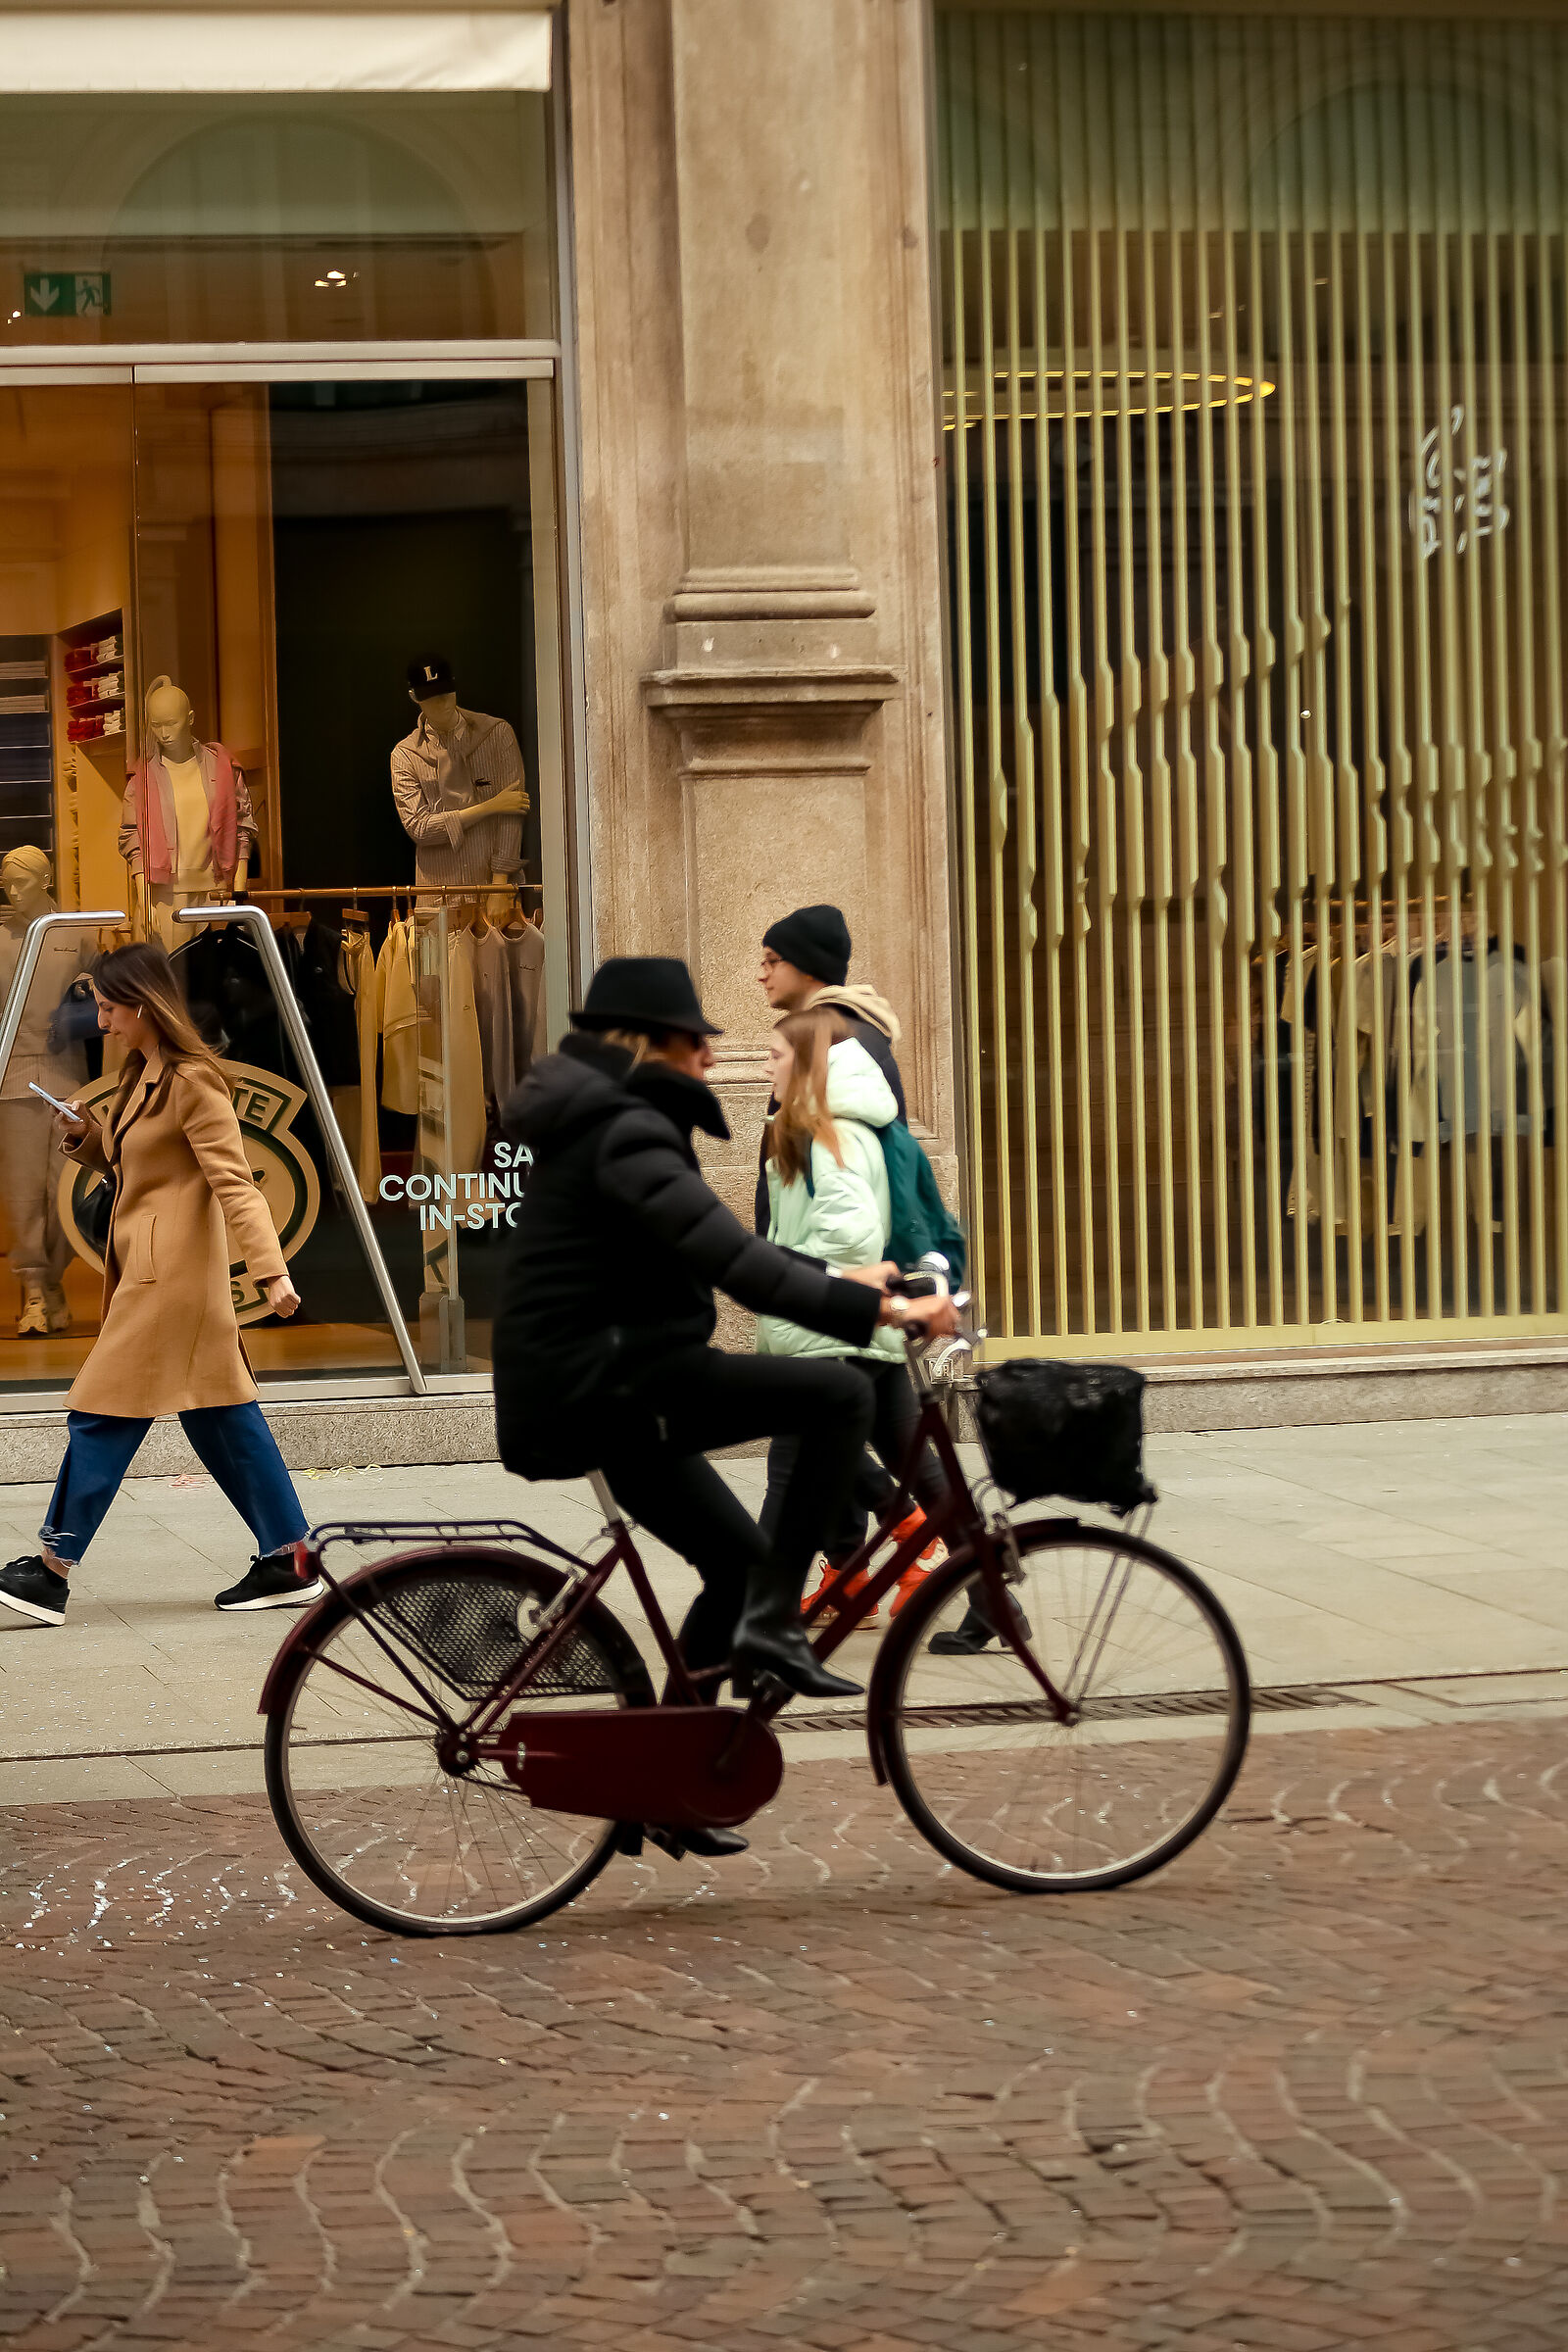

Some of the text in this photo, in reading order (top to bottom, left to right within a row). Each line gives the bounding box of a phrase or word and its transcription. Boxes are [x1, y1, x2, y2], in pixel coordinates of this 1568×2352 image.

[423, 665, 438, 682] L
[494, 1142, 534, 1168] SA
[379, 1172, 525, 1201] CONTINU
[419, 1201, 522, 1231] IN-STO
